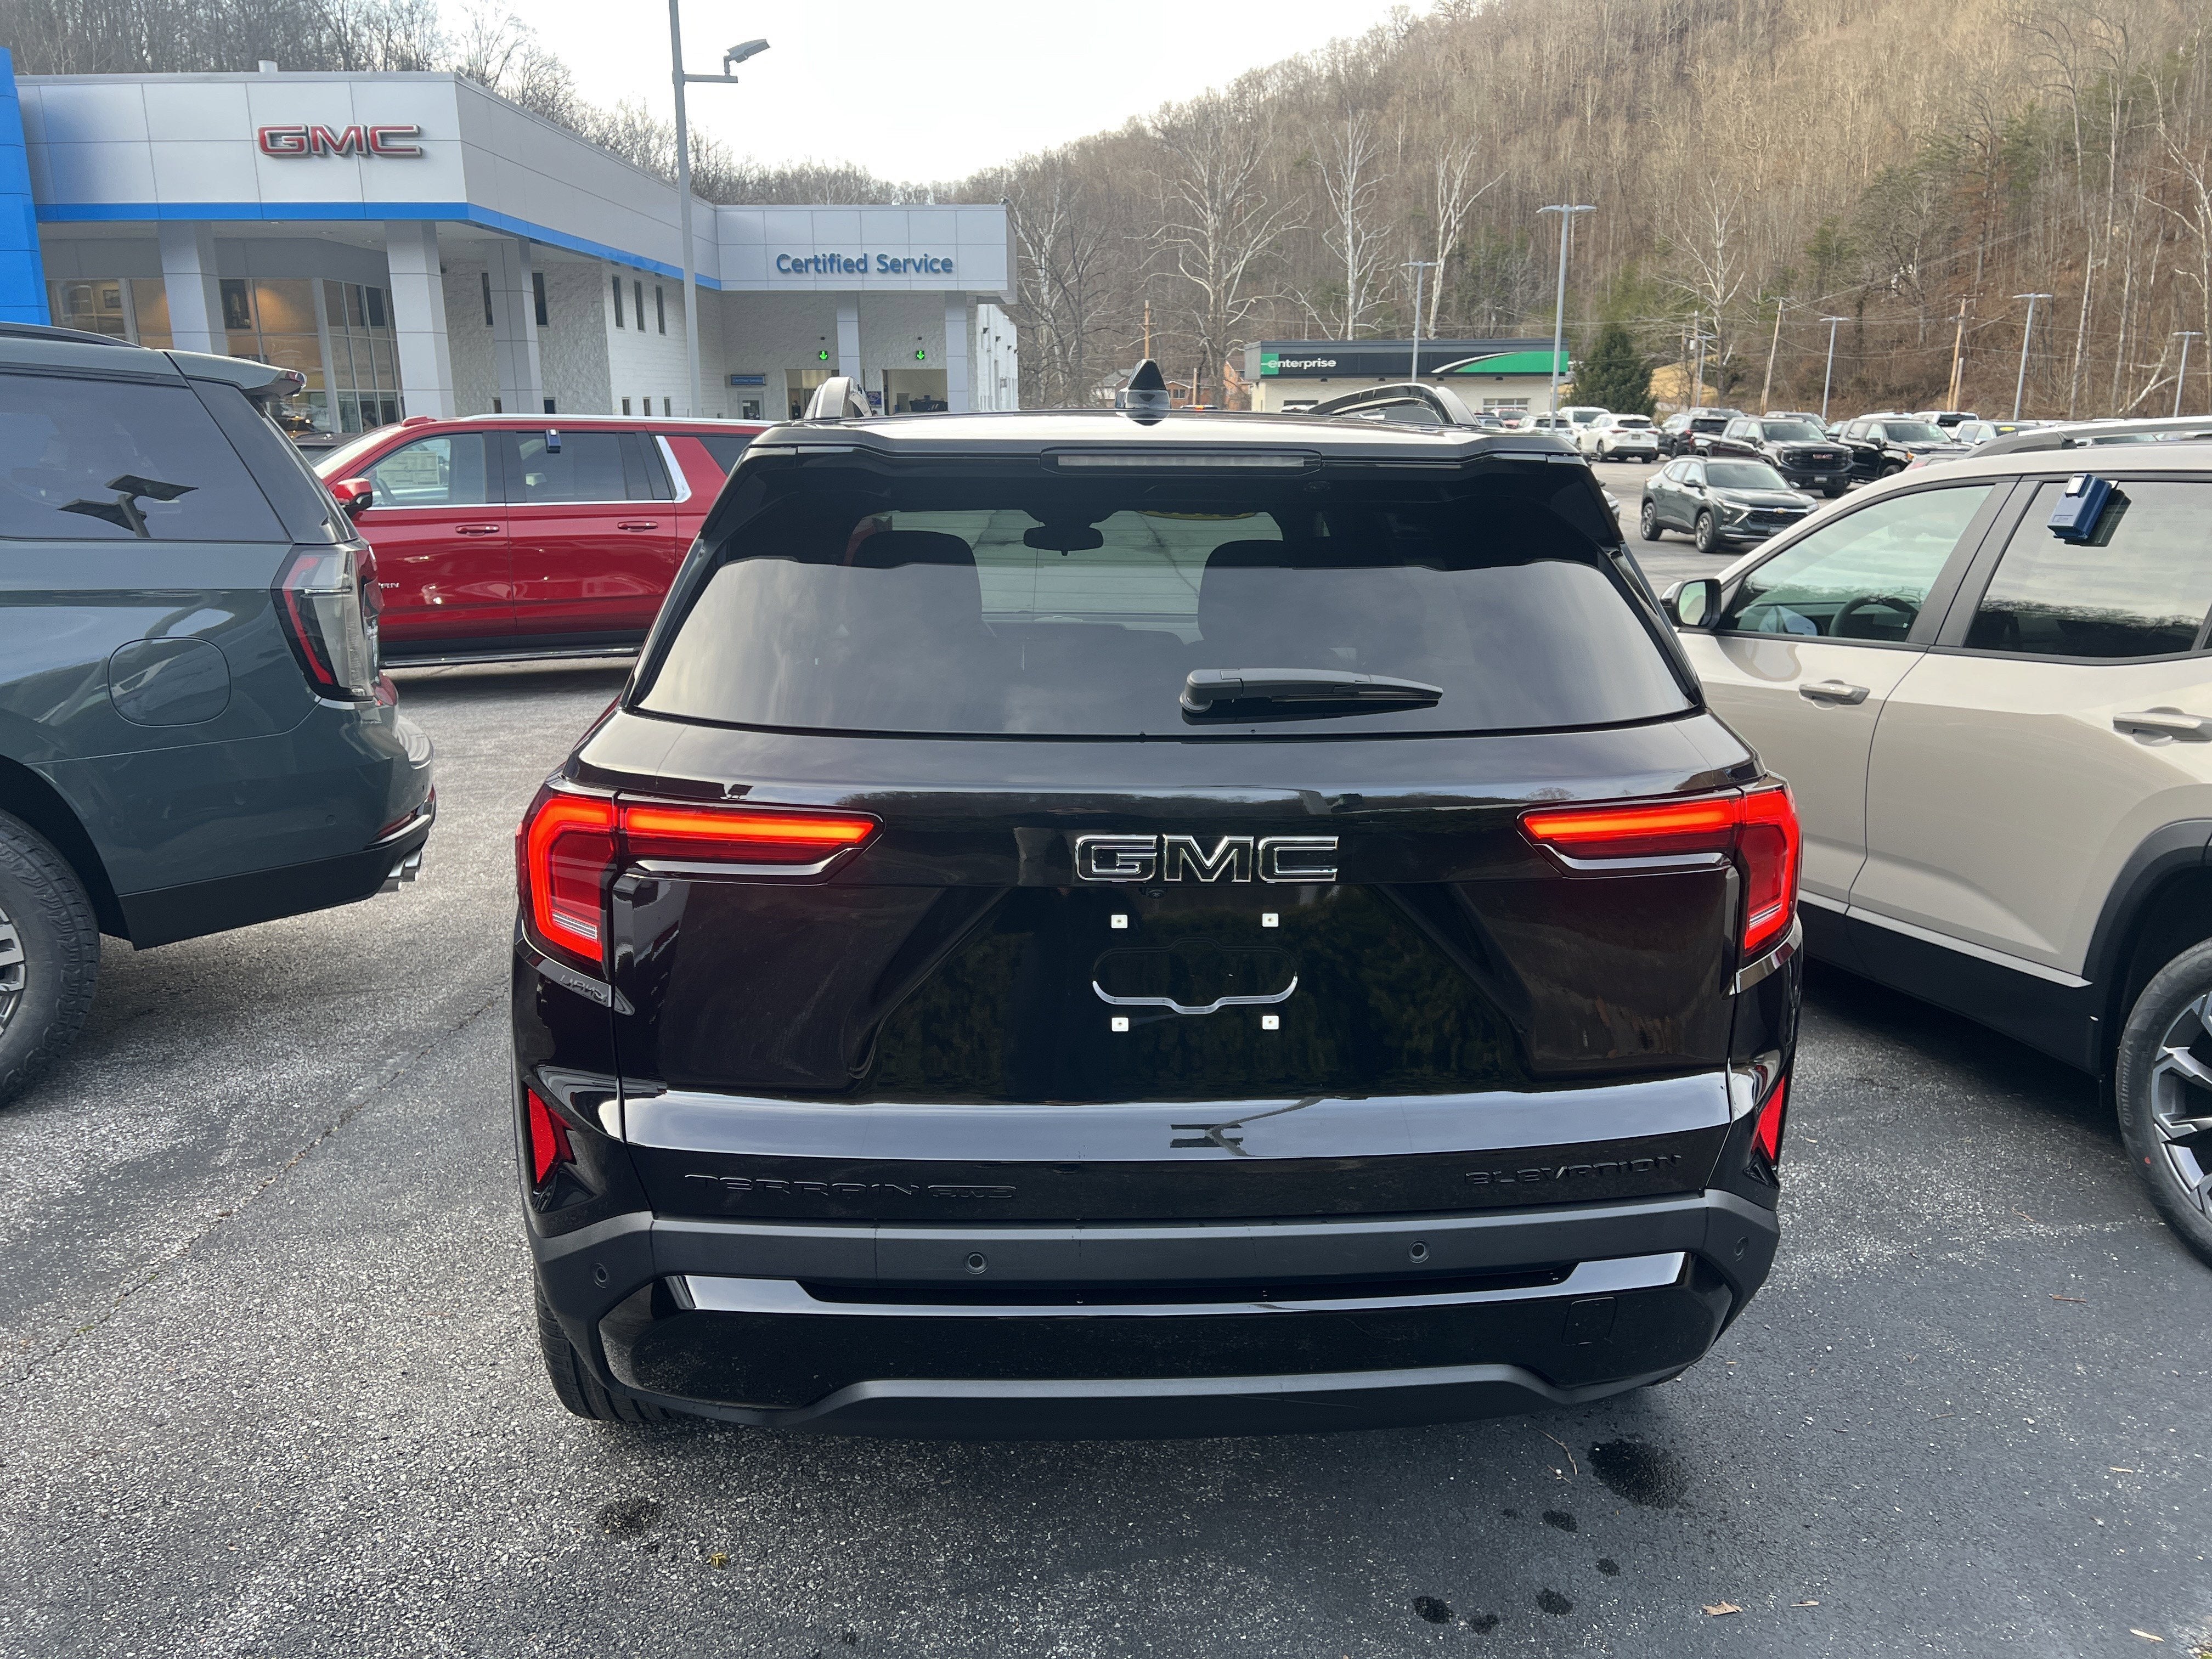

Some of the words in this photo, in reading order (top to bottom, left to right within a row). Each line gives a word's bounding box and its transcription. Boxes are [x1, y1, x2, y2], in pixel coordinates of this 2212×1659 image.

[257, 124, 422, 155] GMC
[776, 253, 868, 274] Certified
[876, 253, 953, 273] Service
[1267, 358, 1337, 370] enterprise
[1075, 834, 1339, 883] GMC
[1465, 1155, 1683, 1185] ELEVATION
[685, 1174, 919, 1198] TERRAIN
